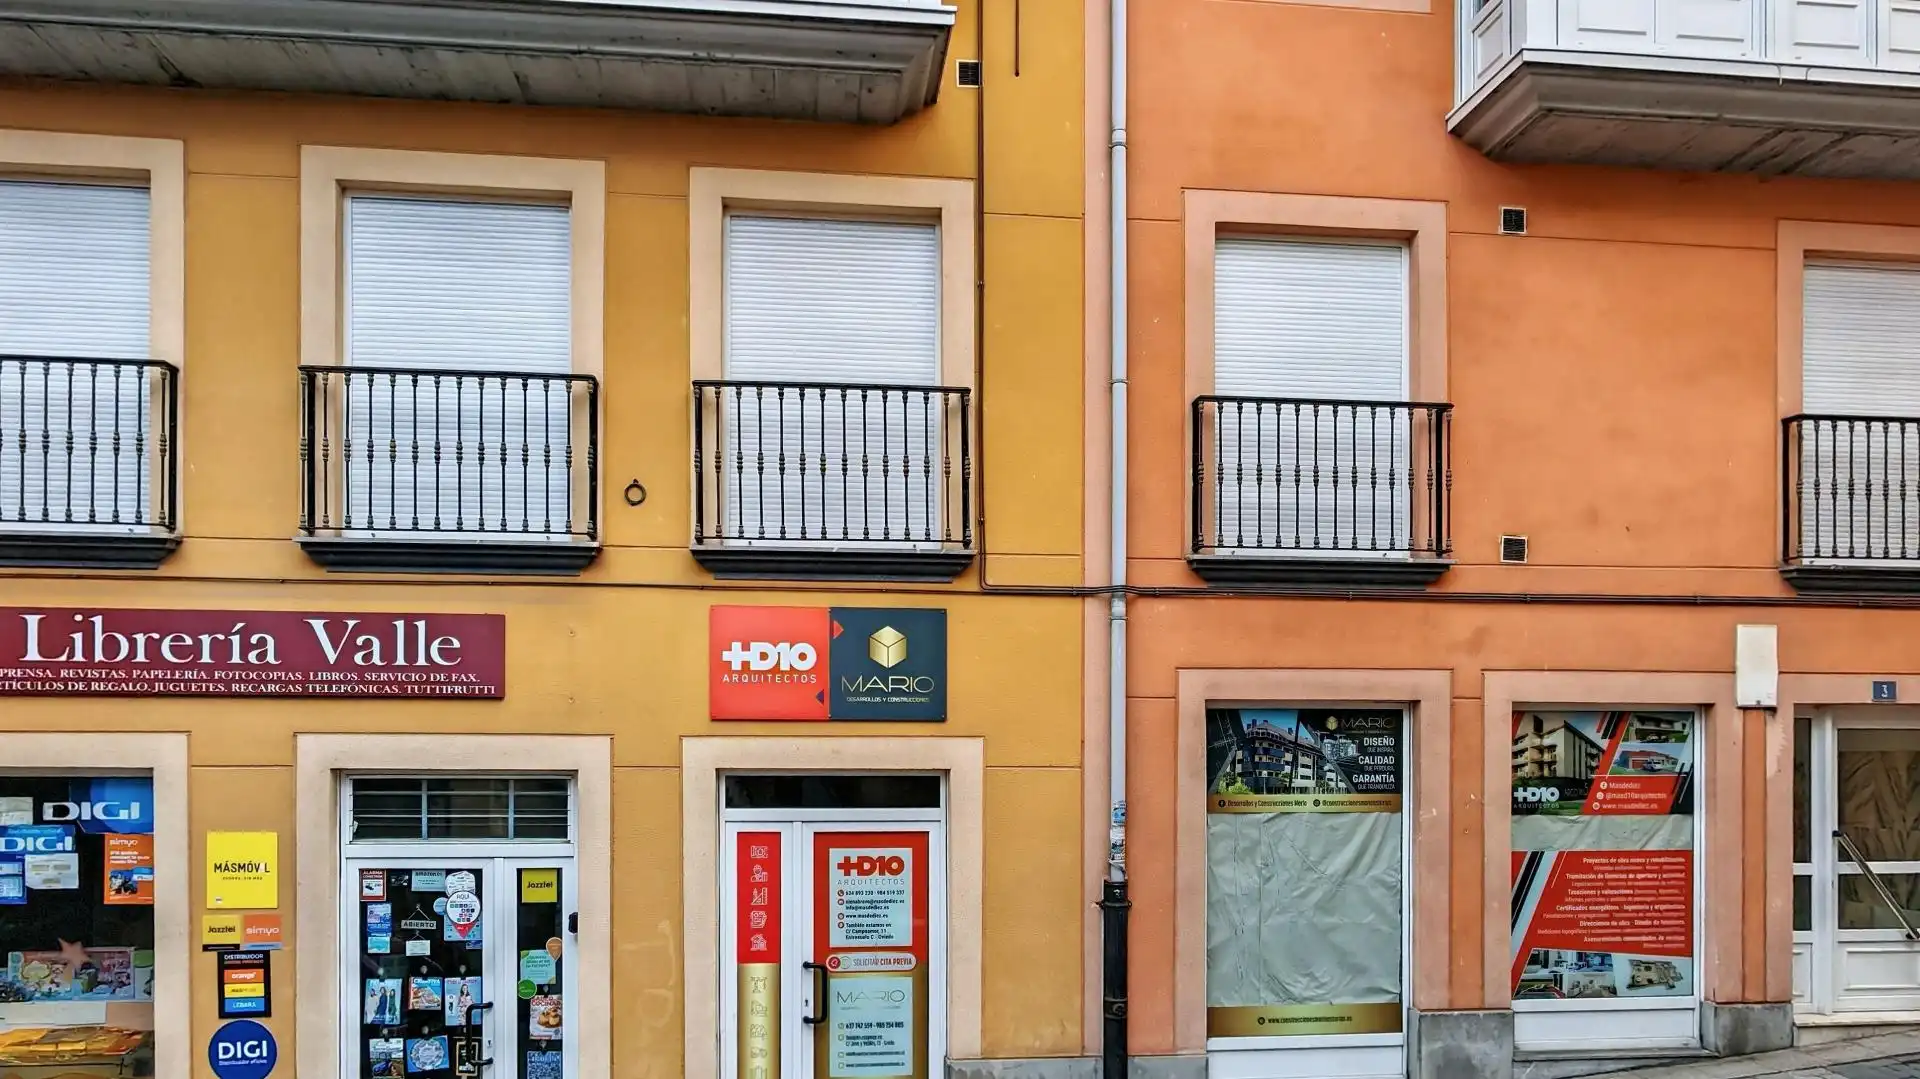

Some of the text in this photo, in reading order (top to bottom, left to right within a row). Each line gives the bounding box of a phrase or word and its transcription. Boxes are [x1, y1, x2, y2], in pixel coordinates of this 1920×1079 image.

[19, 613, 462, 667] Librería Valle
[0, 668, 480, 683] PRENSA. REVISTAS. PAPELERÍA. FOTOCOPIAS. LIBROS. SERVICIO DE FAX.
[722, 674, 817, 683] ARQUITECTOS
[67, 681, 88, 691] DE
[91, 682, 150, 692] REGALO.
[152, 683, 228, 693] JUGUETES.
[232, 684, 302, 693] RECARGAS
[306, 683, 402, 695] TELEFÓNICAS.
[405, 685, 496, 695] TUTTIFRUTTI
[841, 674, 935, 693] MARIO
[1881, 684, 1888, 698] 3
[1363, 735, 1395, 746] DISEÑO
[1358, 755, 1395, 764] CALIDAD
[1352, 772, 1395, 783] GARANTÍA
[43, 802, 140, 820] DIGI
[0, 836, 73, 852] DIGI
[837, 878, 905, 886] ARQUITECTOS
[246, 926, 279, 936] simyo
[880, 958, 892, 966] CITA
[893, 957, 912, 966] PREVIA
[218, 1040, 268, 1060] DIGI
